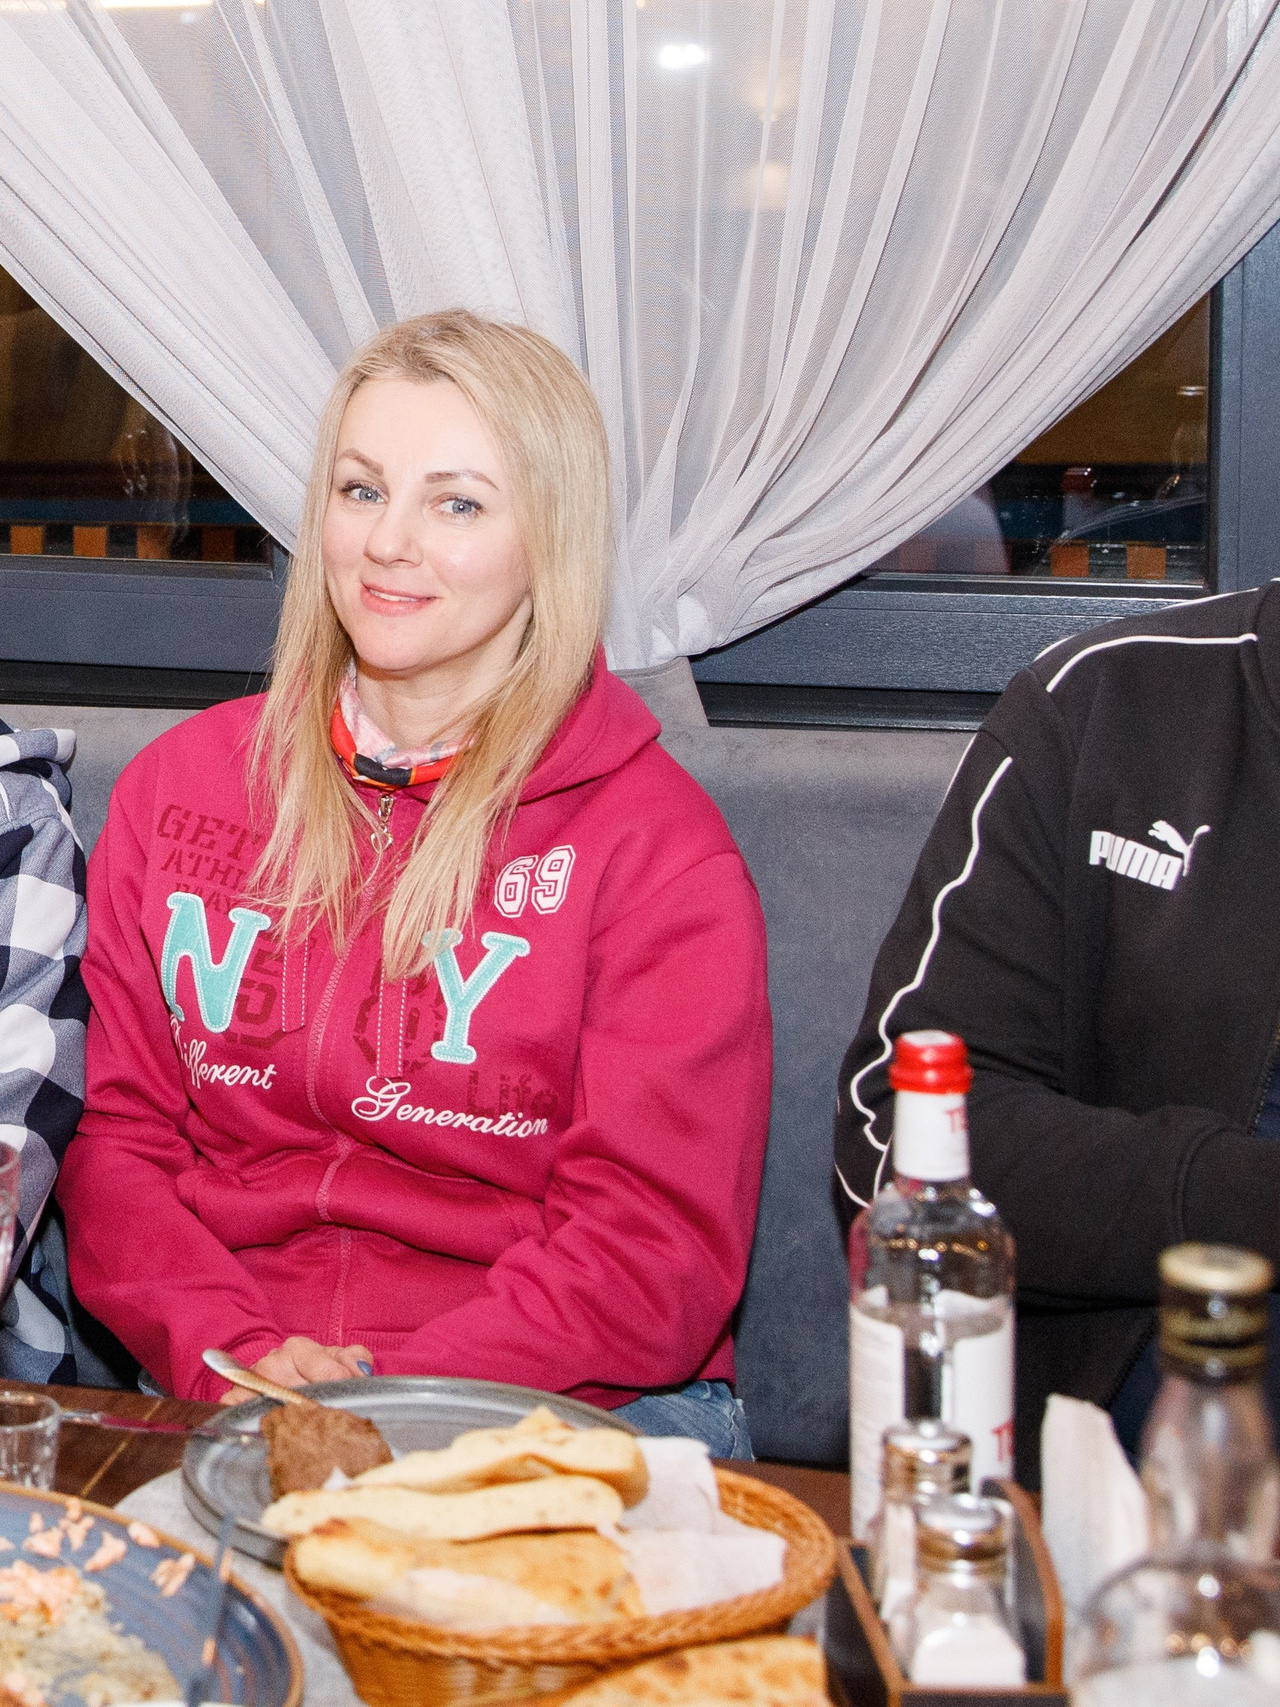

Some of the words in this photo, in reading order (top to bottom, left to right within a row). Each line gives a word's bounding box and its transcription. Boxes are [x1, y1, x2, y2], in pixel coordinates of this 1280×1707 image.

[494, 845, 576, 918] 69
[1088, 830, 1183, 890] PUMA
[351, 1075, 548, 1138] Generation
